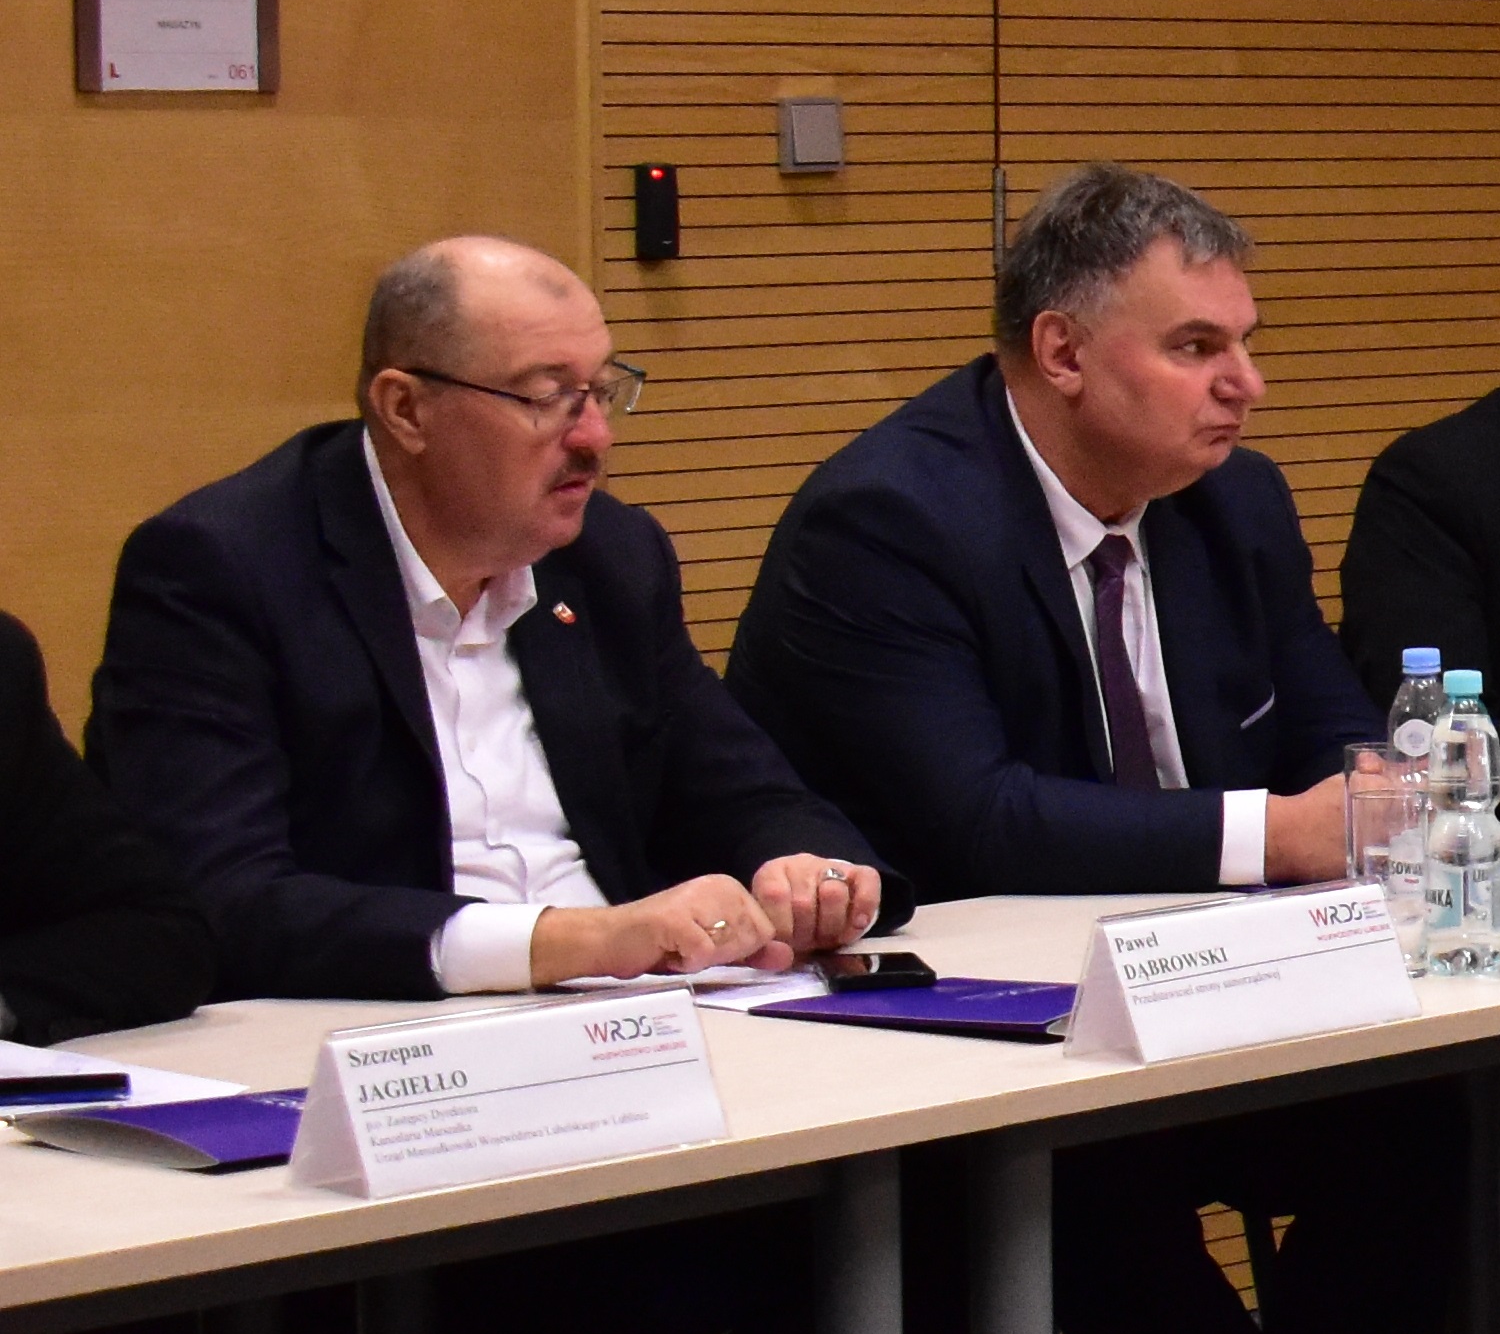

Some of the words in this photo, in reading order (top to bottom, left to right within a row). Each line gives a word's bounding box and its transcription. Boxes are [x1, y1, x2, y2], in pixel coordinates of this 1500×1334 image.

[1309, 901, 1363, 927] WRDS
[584, 1015, 653, 1045] WRDS
[348, 1043, 434, 1068] Szczepan
